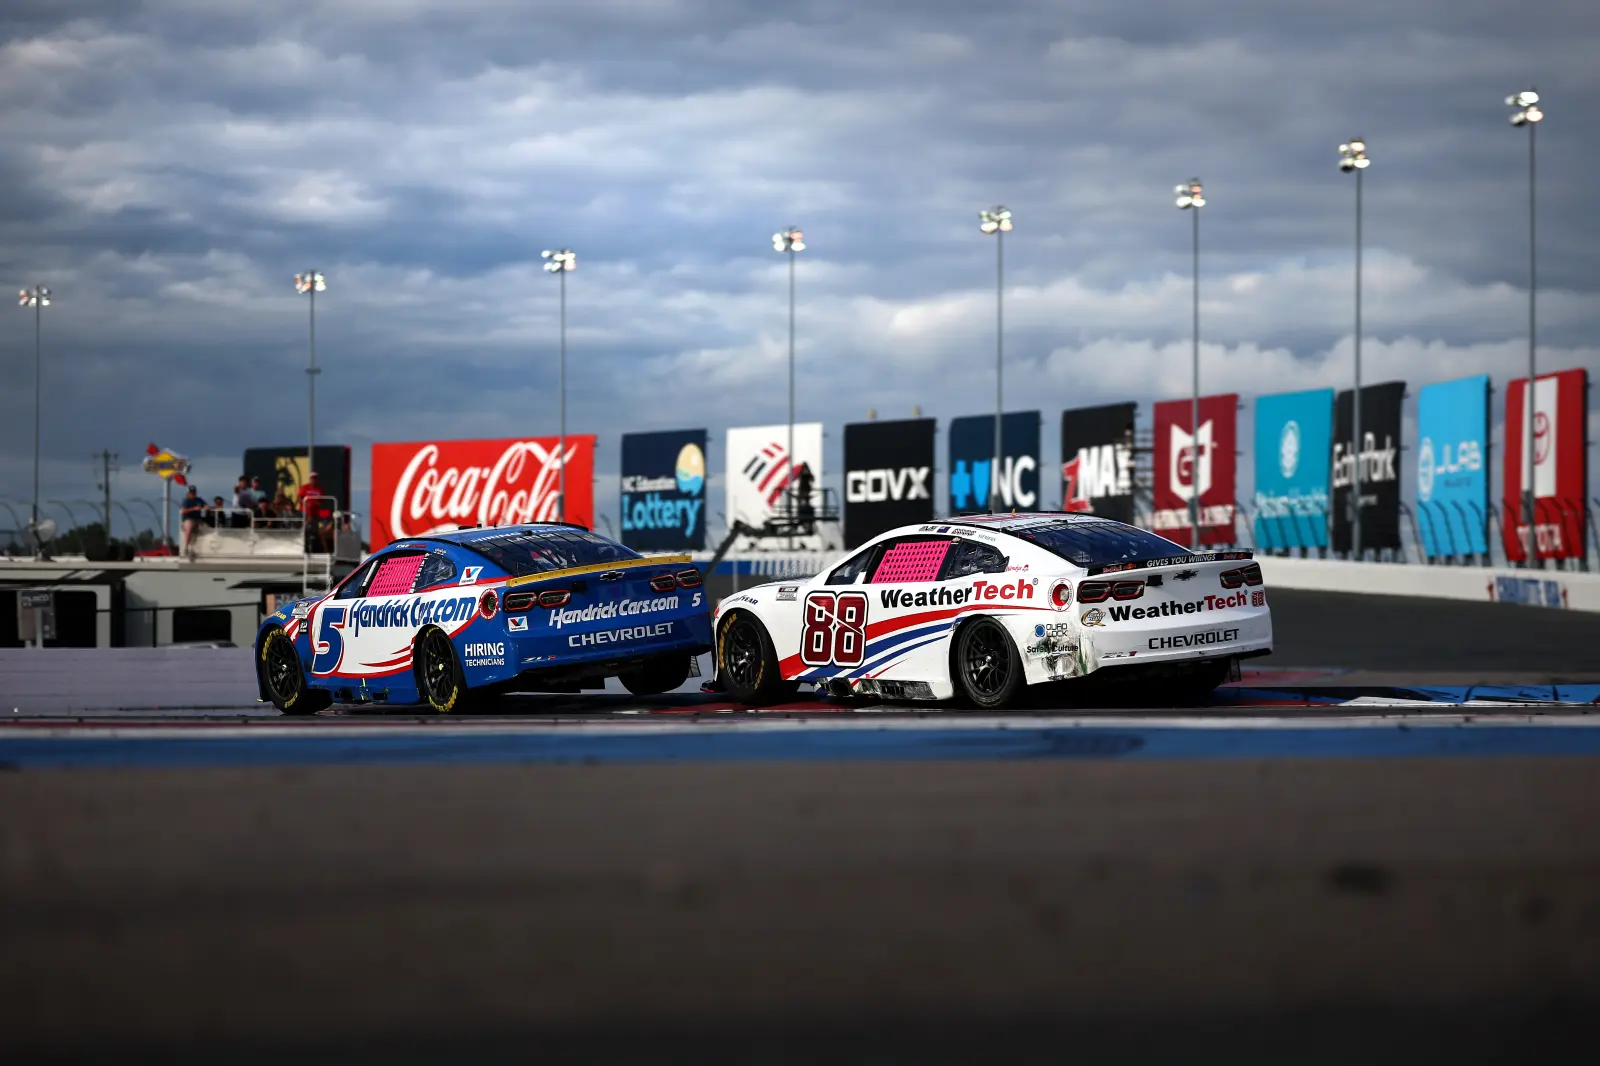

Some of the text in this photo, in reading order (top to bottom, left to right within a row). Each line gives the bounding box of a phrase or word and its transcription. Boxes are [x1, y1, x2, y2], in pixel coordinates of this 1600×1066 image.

[847, 467, 928, 502] GOVX
[991, 455, 1036, 507] NC
[622, 492, 702, 537] Lottery
[1516, 525, 1563, 553] TOOTA
[691, 593, 702, 607] 5
[880, 579, 1034, 608] WeatherTech
[1108, 593, 1247, 622] WeatherTech
[1251, 591, 1265, 607] 88
[311, 606, 348, 676] 5
[568, 622, 674, 648] CHEVROLET
[801, 590, 869, 667] 88
[1148, 628, 1240, 649] CHEVROLET
[464, 642, 505, 657] HIRING
[465, 657, 505, 667] TECHNICIANS
